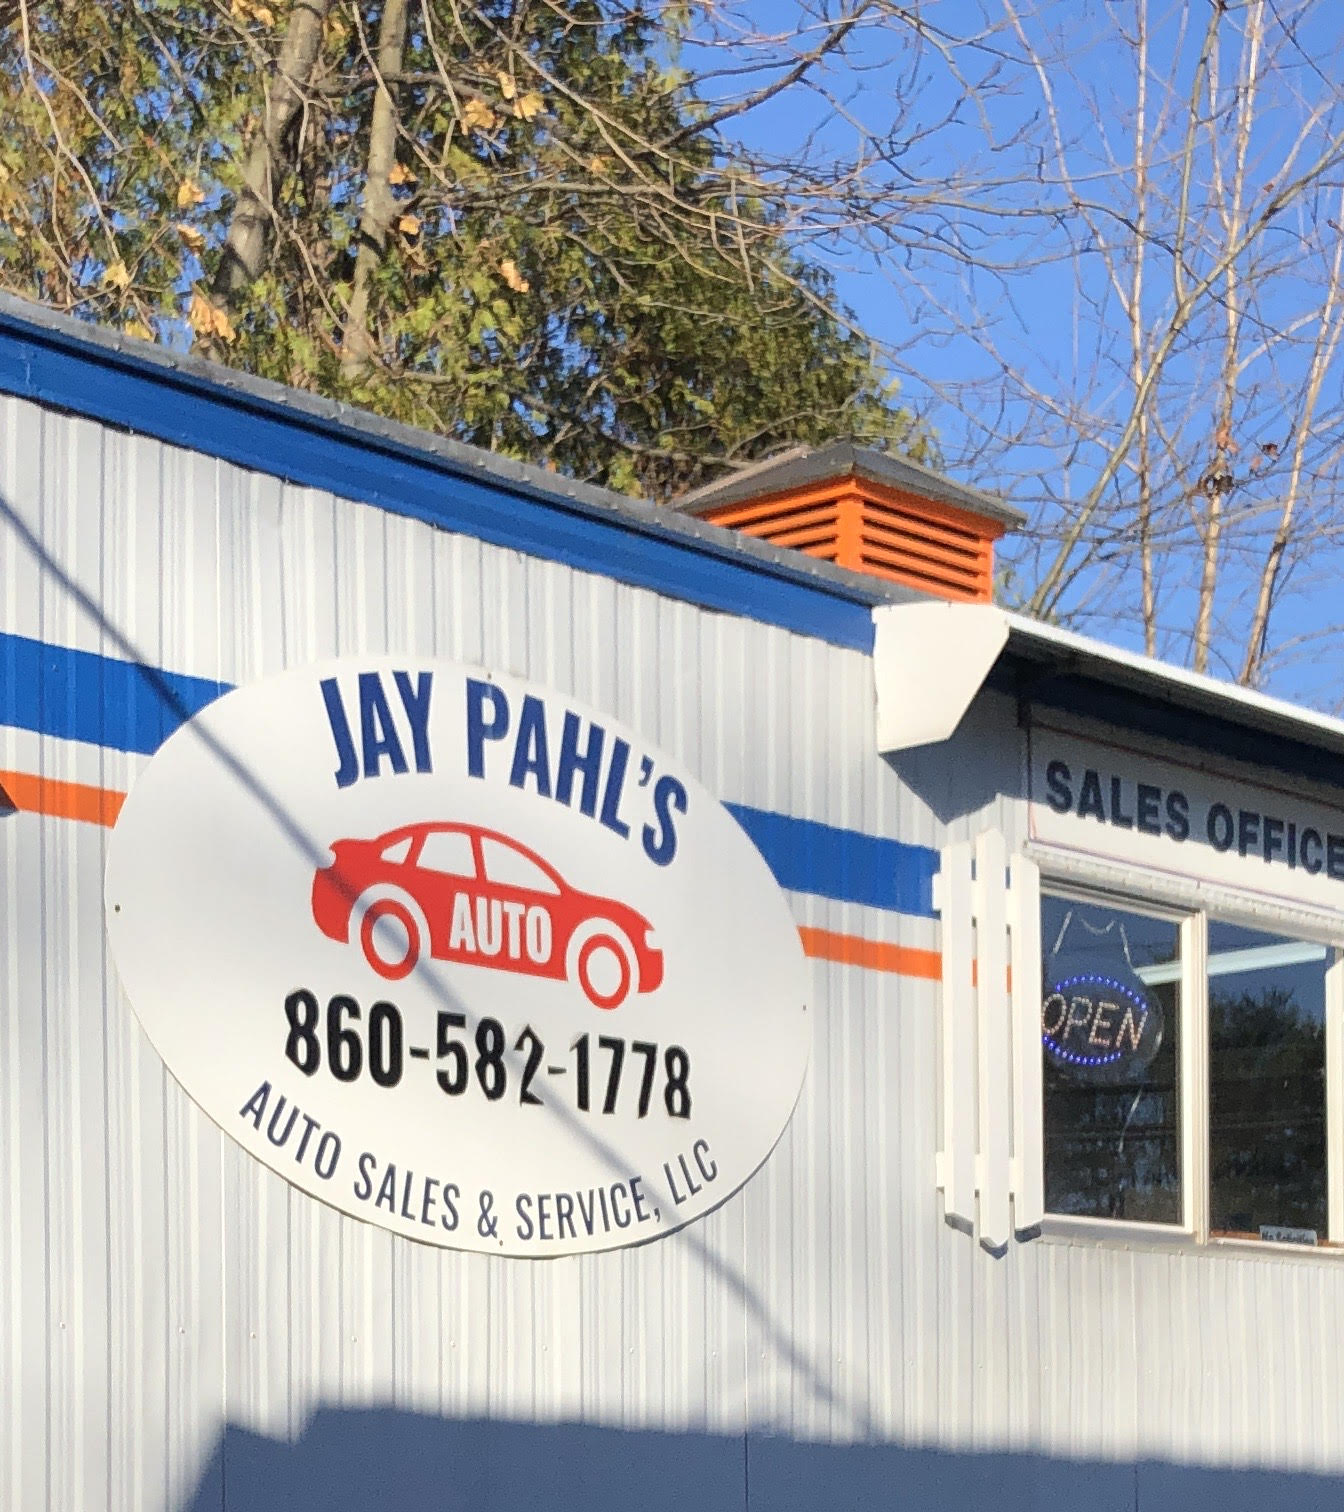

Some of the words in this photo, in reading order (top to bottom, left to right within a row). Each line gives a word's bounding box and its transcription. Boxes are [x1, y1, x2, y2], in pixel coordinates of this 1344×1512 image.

[320, 671, 433, 788] JAY
[466, 679, 688, 866] PAHL'S
[1047, 761, 1190, 841] SALES
[449, 893, 553, 964] AUTO
[284, 988, 692, 1119] 860-582-1778
[1041, 993, 1149, 1050] OPEN
[240, 1081, 342, 1180] AUTO
[354, 1153, 460, 1232] SALES
[477, 1190, 499, 1239] &
[516, 1177, 662, 1241] SERVICE,
[664, 1140, 718, 1205] LLC
